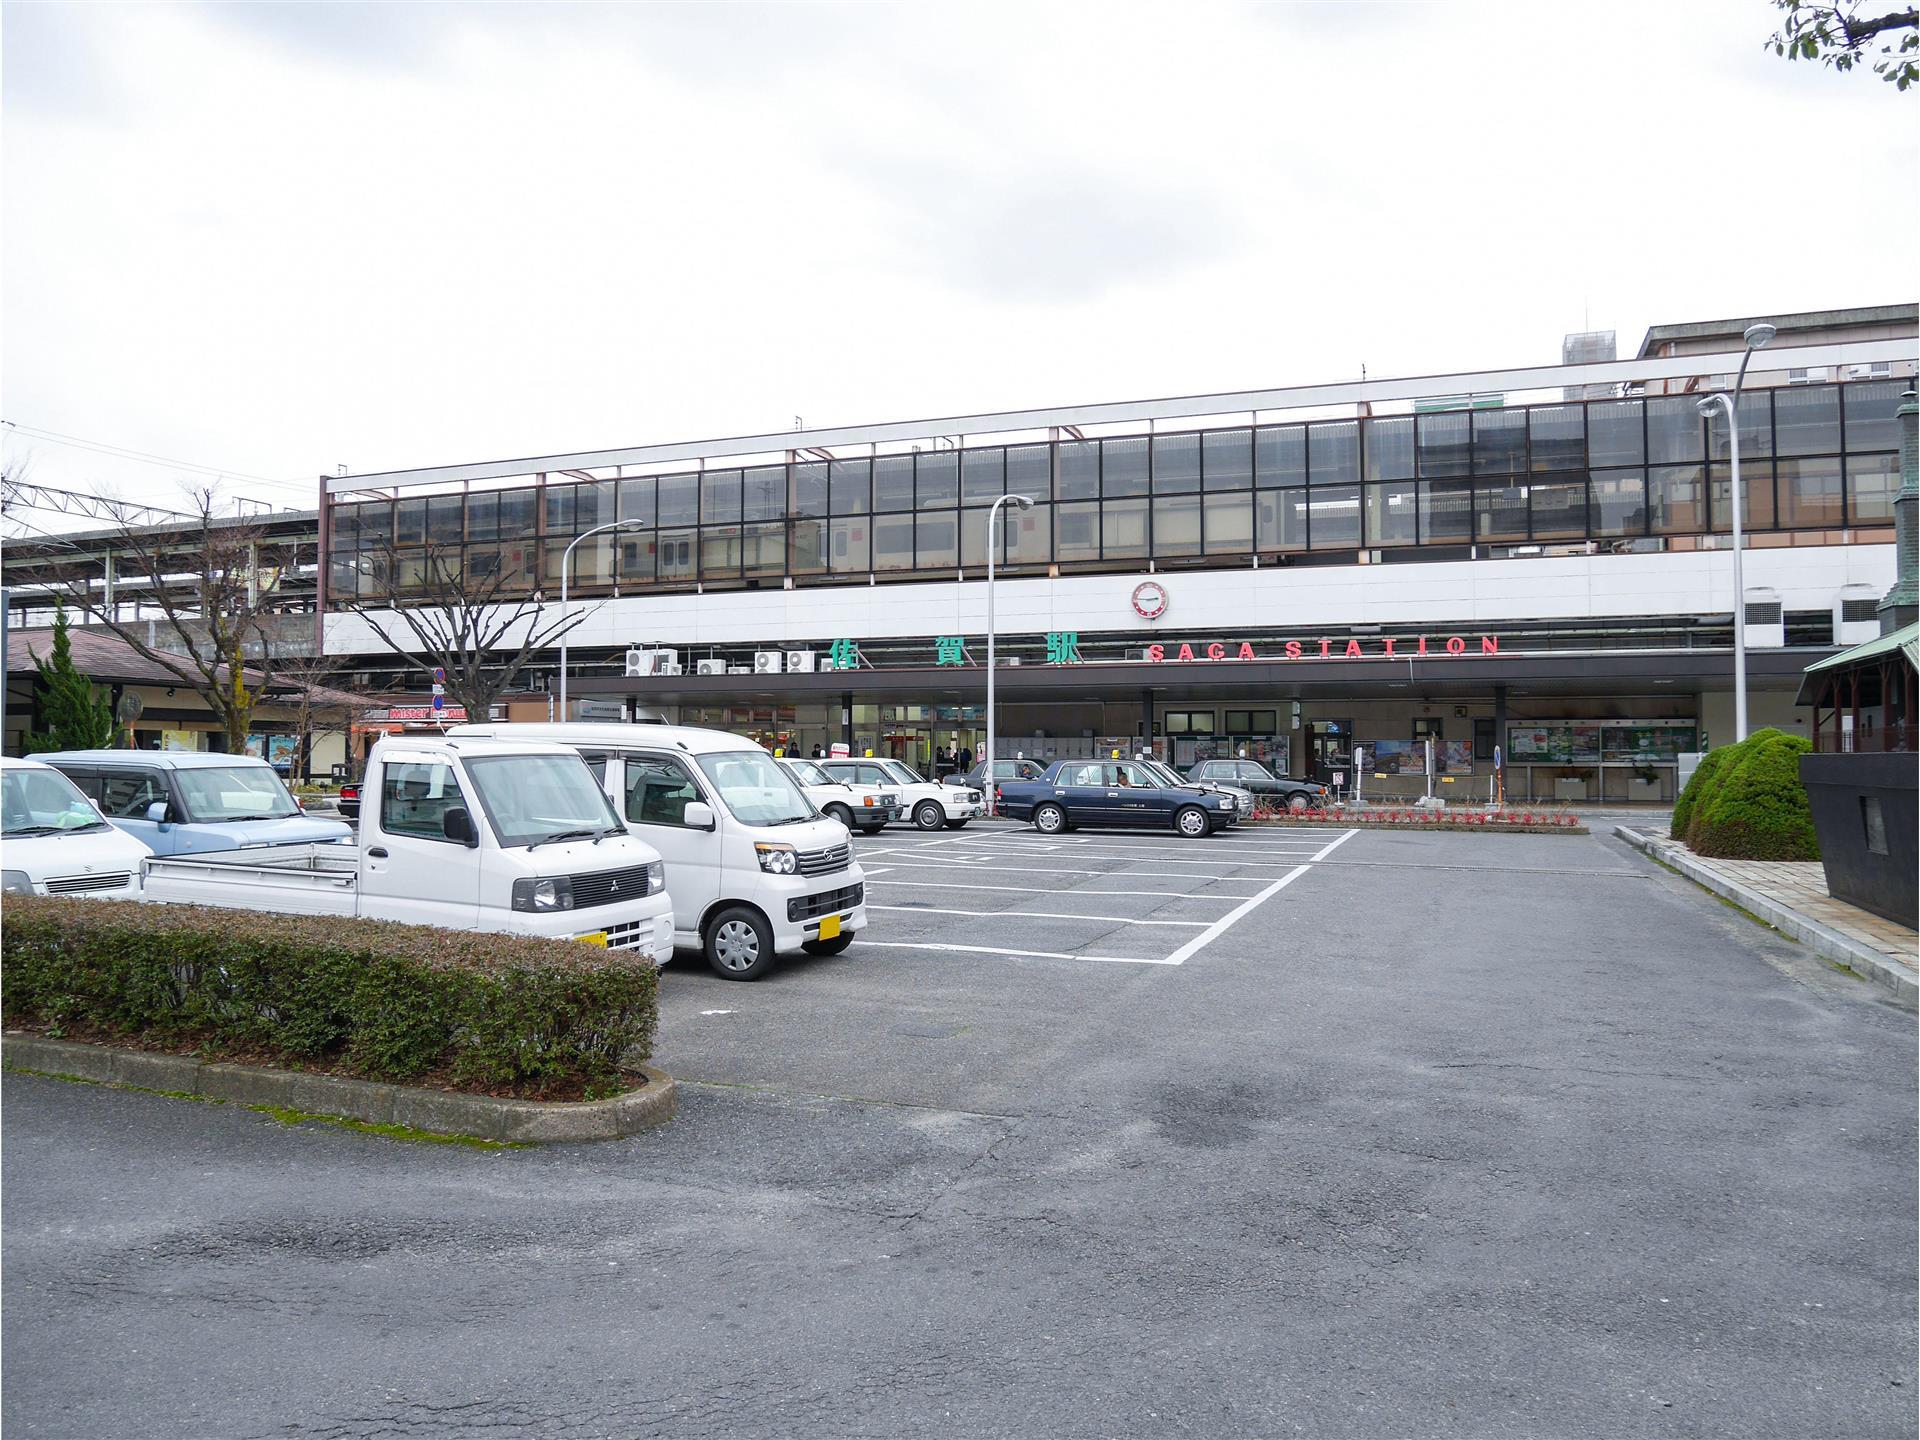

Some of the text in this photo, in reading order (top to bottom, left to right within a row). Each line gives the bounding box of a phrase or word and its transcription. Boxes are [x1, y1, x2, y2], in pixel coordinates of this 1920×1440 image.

[1148, 636, 1499, 662] SAGA STATION
[389, 708, 430, 719] mister
